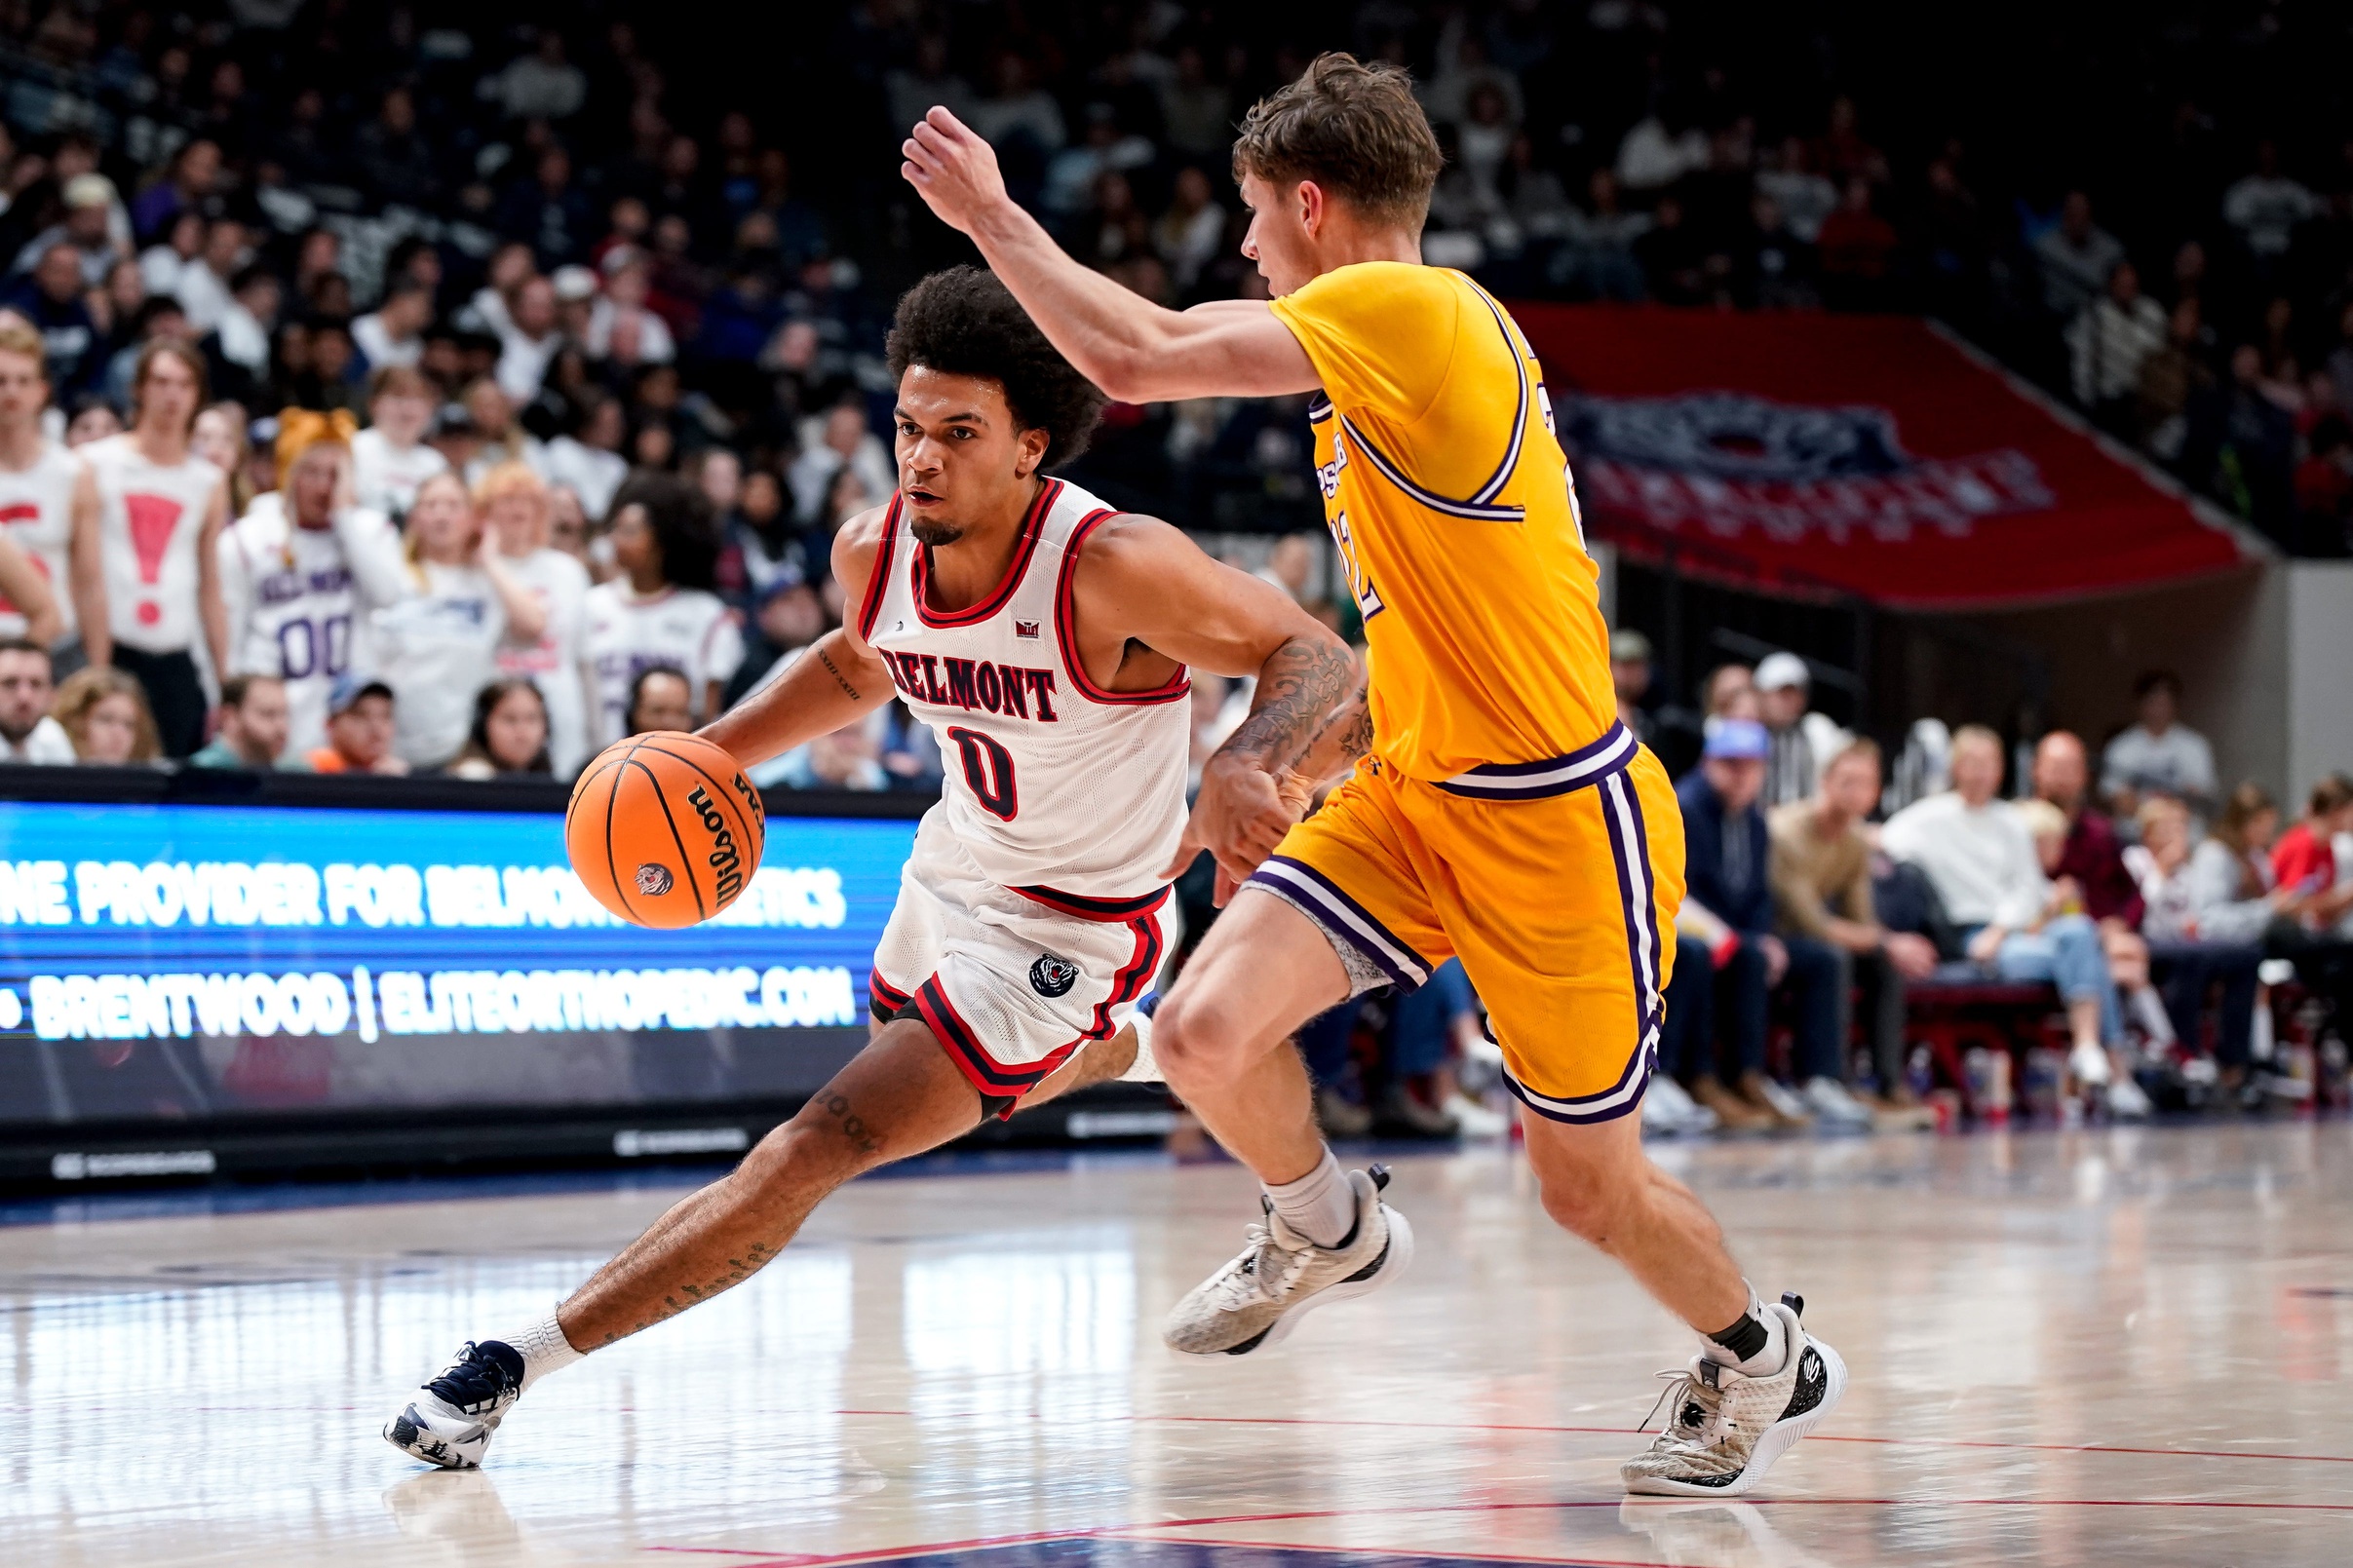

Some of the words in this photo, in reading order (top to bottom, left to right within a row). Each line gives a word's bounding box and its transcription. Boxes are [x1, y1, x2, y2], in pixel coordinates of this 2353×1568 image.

[877, 645, 1059, 723] BELMONT
[732, 771, 765, 844] CAA
[946, 725, 1019, 822] 0
[686, 783, 746, 908] Wilson
[74, 861, 324, 927] PROVIDER
[324, 863, 426, 928] FOR
[426, 864, 626, 928] BELMO
[29, 972, 352, 1041] BRENTWOOD
[378, 966, 857, 1035] ELITEORTHOPEDIC.COM
